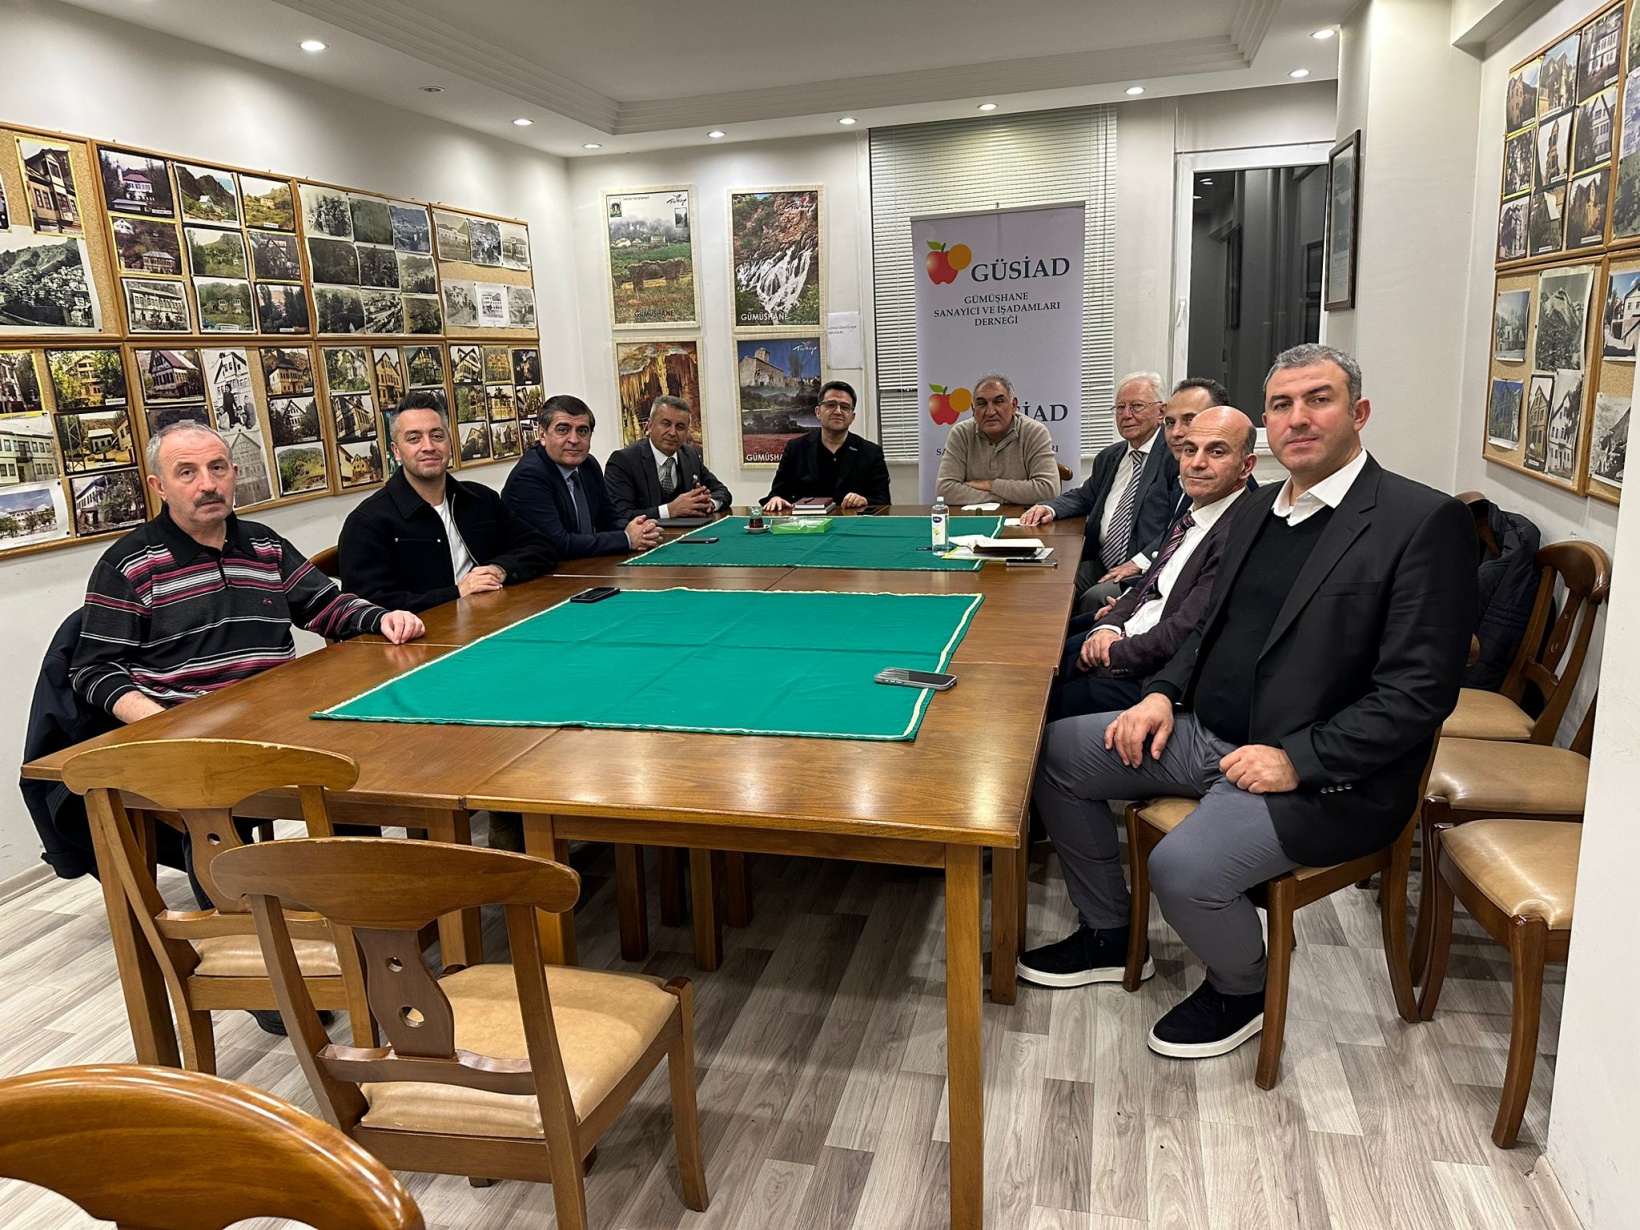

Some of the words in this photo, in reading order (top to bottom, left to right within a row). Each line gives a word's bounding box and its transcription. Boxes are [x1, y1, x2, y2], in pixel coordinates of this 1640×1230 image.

[971, 256, 1070, 282] GÜSİAD
[964, 292, 1029, 304] GÜMÜŞHANE
[934, 306, 980, 317] SANAYİCİ
[982, 305, 995, 315] VE
[974, 315, 1019, 326] DERNEĞİ
[1017, 401, 1069, 422] İAD
